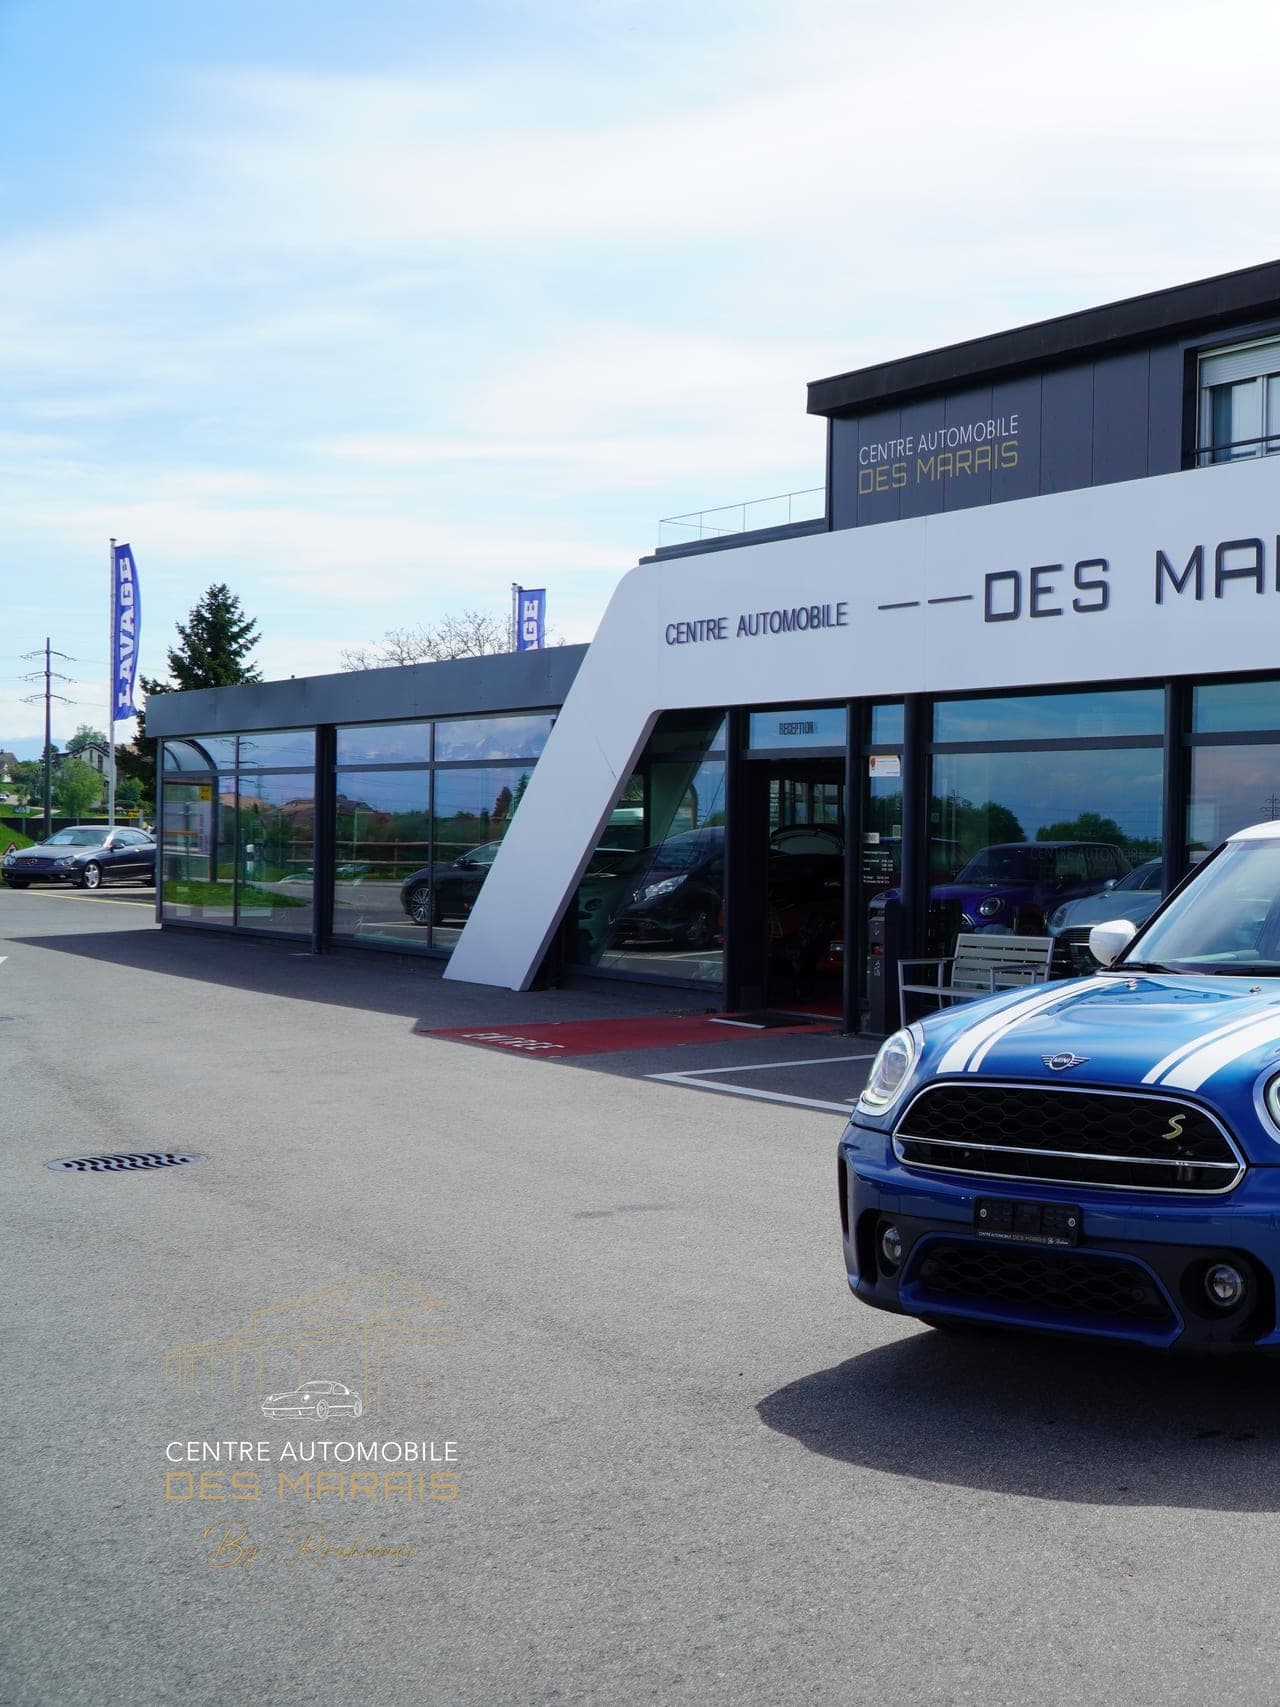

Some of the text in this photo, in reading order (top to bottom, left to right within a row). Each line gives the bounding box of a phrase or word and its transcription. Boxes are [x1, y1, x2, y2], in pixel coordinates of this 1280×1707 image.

[858, 414, 1019, 465] CENTRE AUTOMOBILE
[858, 440, 1019, 494] DES MARAIS
[984, 558, 1110, 623] DES
[118, 557, 135, 708] LAVAGE
[665, 602, 849, 646] CENTRE AUTOMOBILE
[778, 721, 814, 736] RECEPTION
[1161, 1113, 1186, 1140] S
